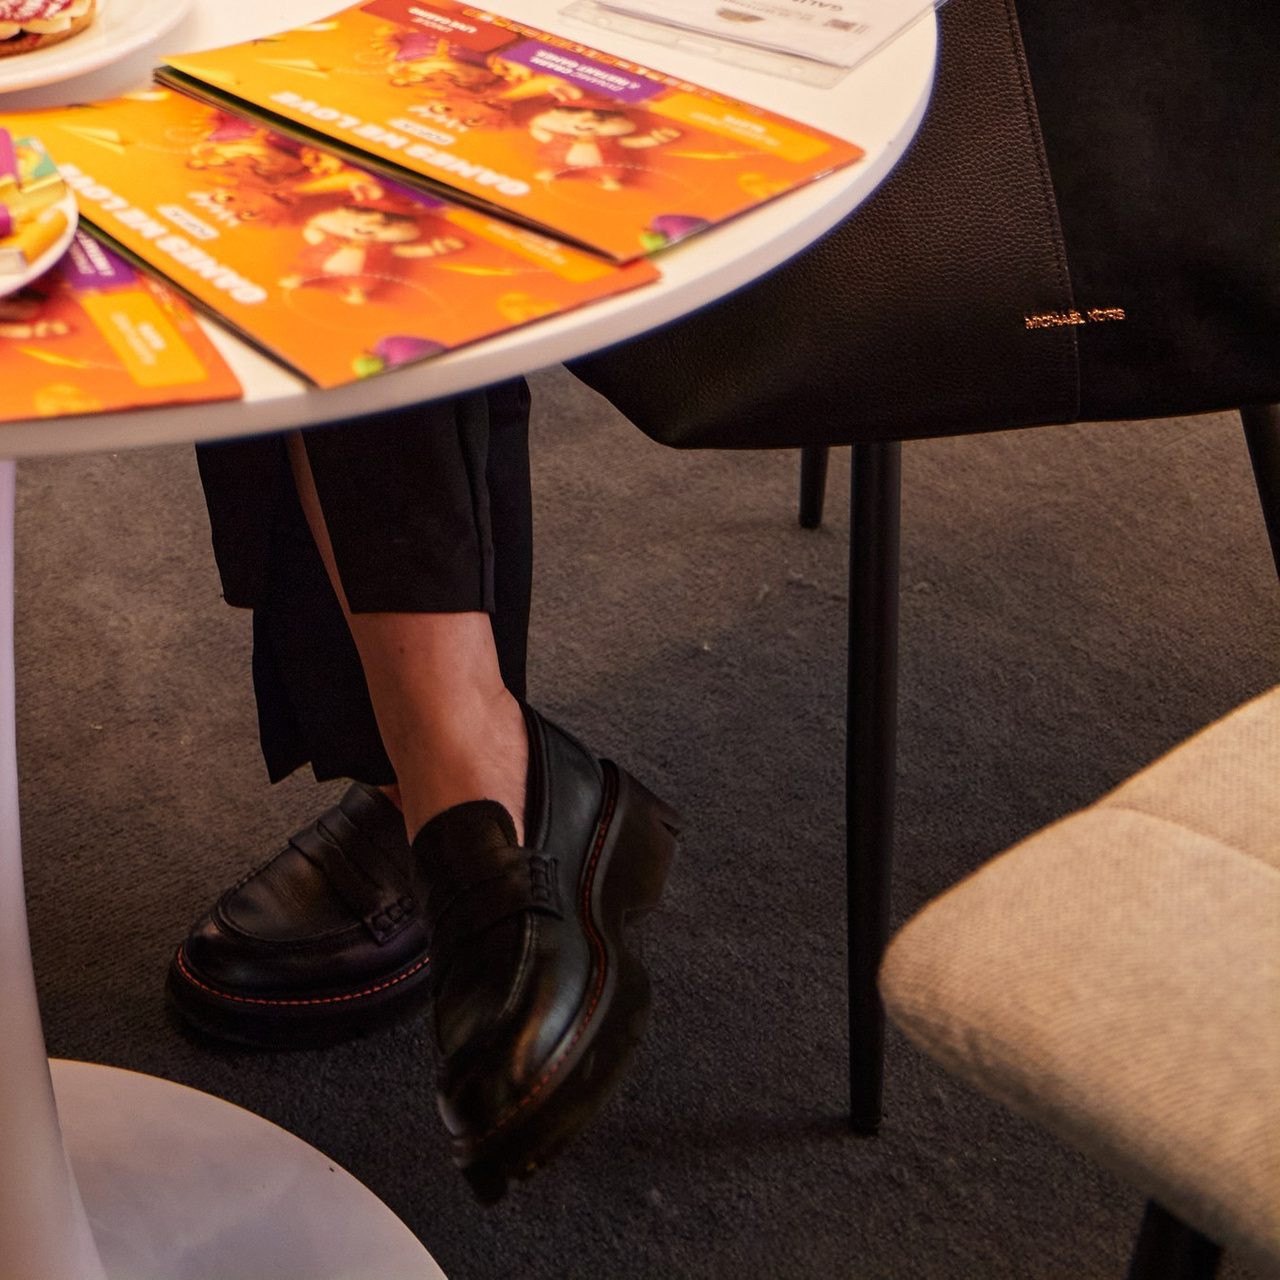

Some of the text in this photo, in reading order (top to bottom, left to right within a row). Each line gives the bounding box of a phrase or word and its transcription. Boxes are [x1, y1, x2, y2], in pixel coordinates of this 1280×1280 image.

[270, 90, 531, 197] GAMES WE LOVE
